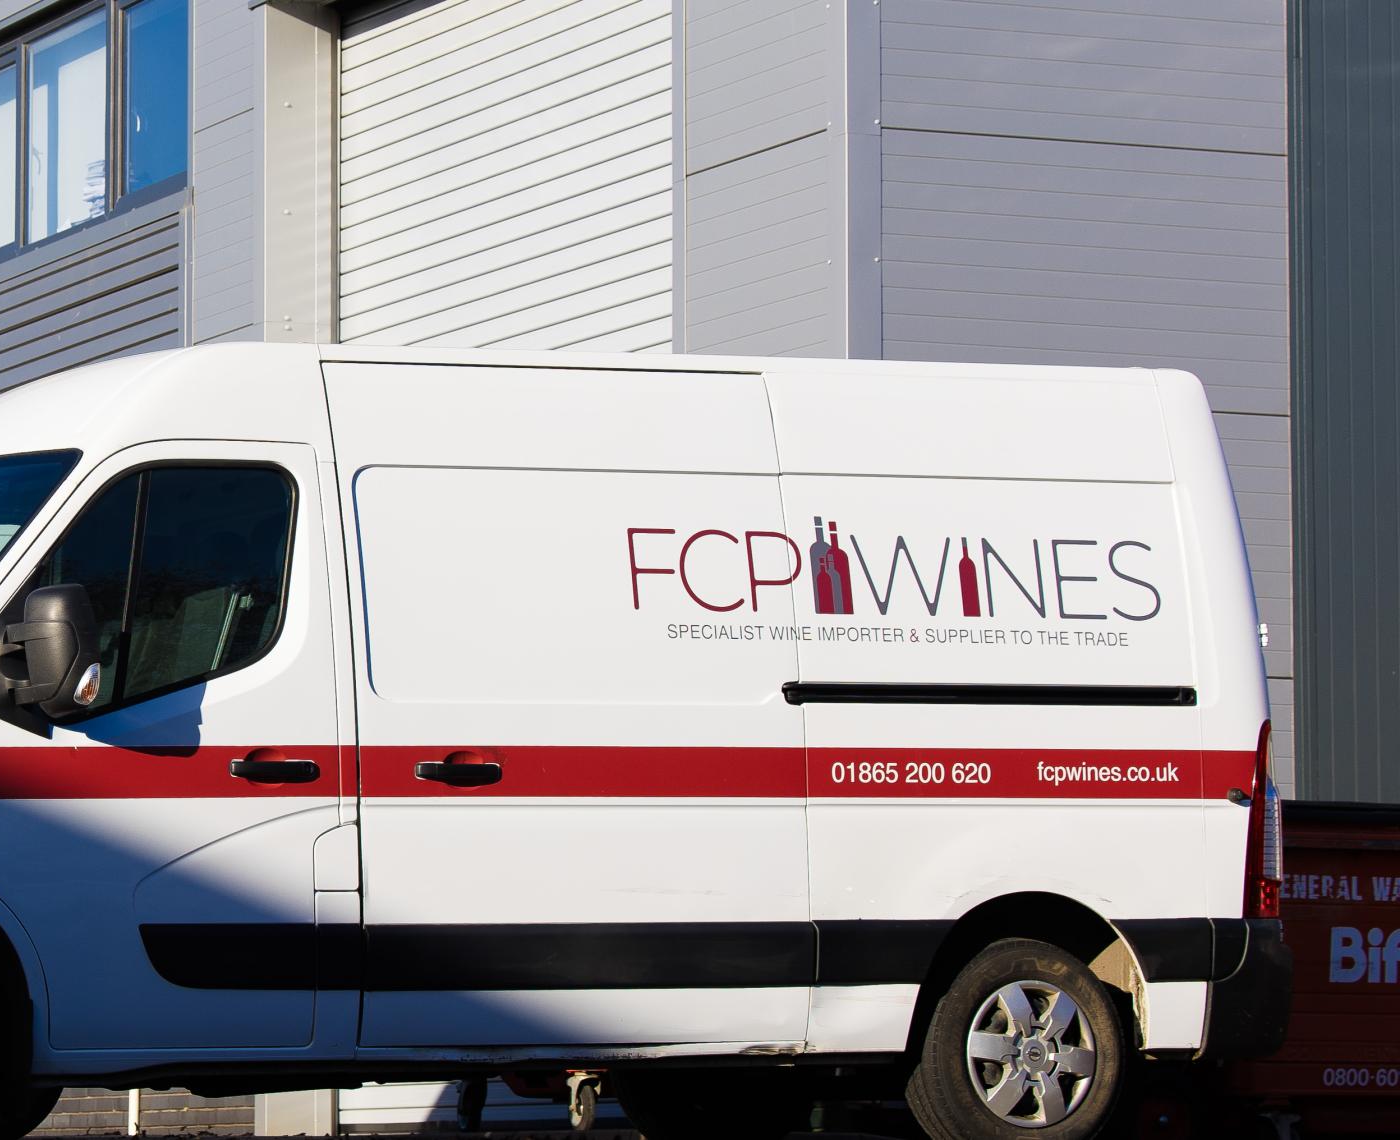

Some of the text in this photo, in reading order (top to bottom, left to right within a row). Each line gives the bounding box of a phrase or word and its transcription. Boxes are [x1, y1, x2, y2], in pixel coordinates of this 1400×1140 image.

[626, 527, 801, 613] FCP
[667, 623, 1129, 647] SPECIALIST WINE IMPORTER & SUPPLIER TO THE TRADE
[831, 762, 992, 784] 01865 200 620
[1036, 760, 1180, 787] fcpwines.co.uk
[1280, 873, 1363, 901] ENERAL
